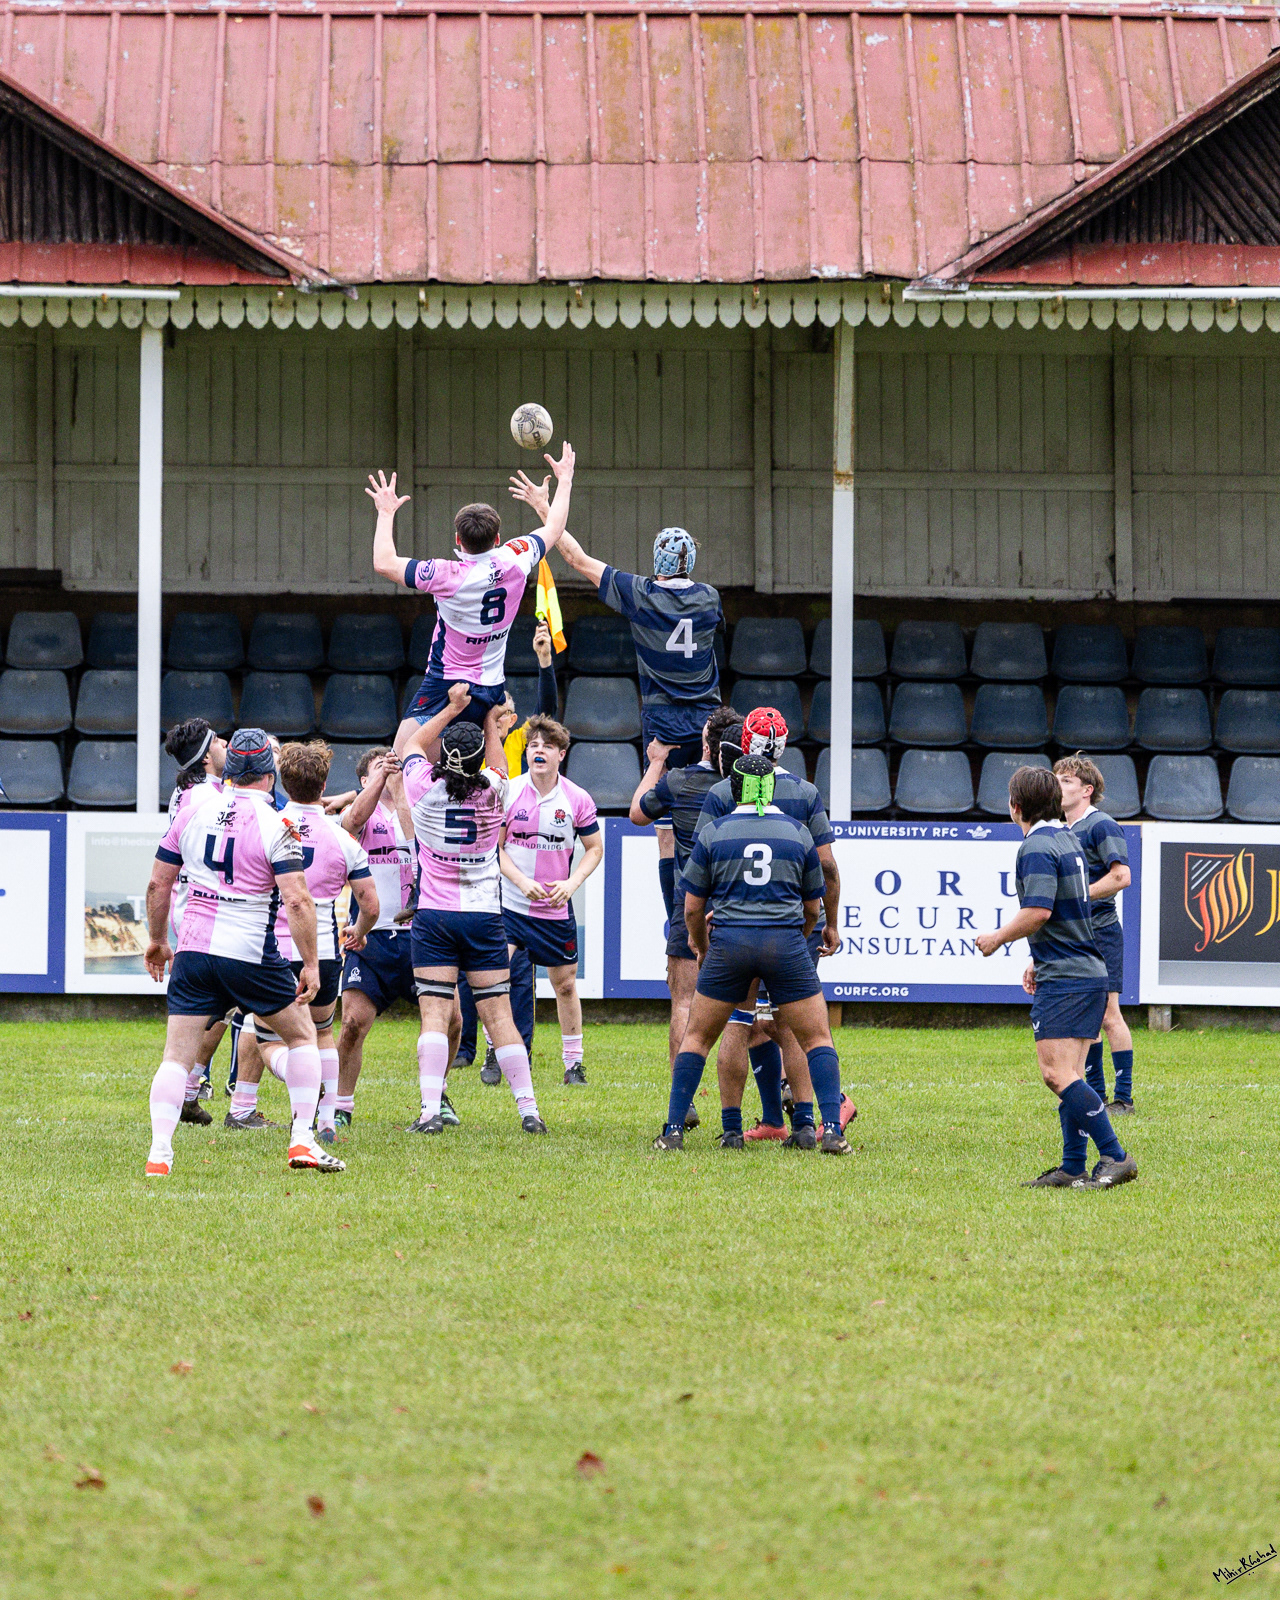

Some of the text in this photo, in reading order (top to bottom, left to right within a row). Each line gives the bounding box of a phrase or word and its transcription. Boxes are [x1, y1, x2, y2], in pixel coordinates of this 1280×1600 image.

[480, 588, 508, 626] 8
[665, 618, 698, 659] 4
[444, 808, 478, 846] 5
[848, 826, 928, 838] UNIVERSITY
[932, 827, 959, 838] RFC
[203, 834, 235, 885] 4
[743, 843, 773, 887] 3
[833, 985, 910, 997] OURFC.ORG
